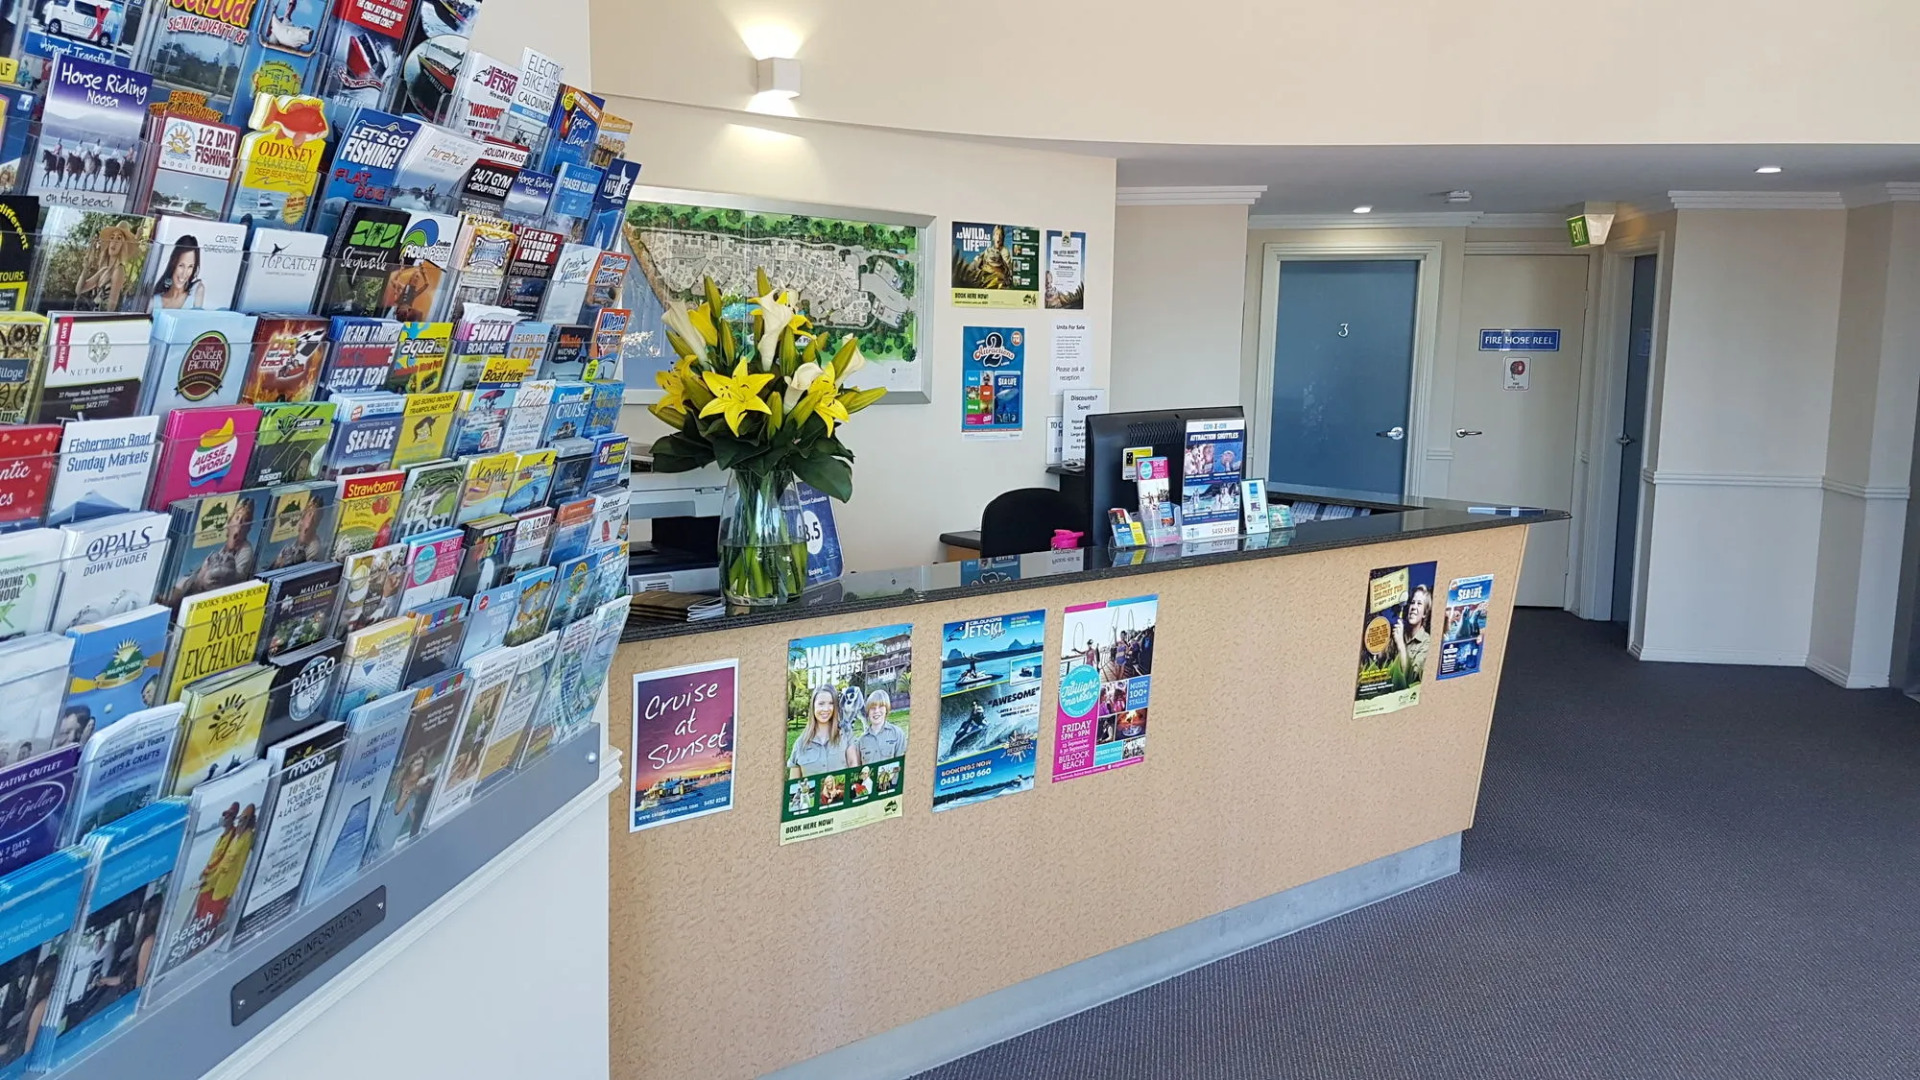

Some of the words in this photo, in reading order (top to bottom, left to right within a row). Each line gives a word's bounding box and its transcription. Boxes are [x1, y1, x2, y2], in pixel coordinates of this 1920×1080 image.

[61, 62, 103, 90] Horse
[105, 74, 149, 105] Riding
[523, 73, 545, 90] BIKE
[86, 90, 119, 108] Noosa
[197, 126, 214, 145] 1/2
[215, 131, 234, 150] DAY
[350, 125, 388, 145] LET'S
[387, 134, 409, 149] GO
[195, 146, 231, 167] FISHING
[258, 140, 316, 162] ODYSSEY
[340, 137, 402, 170] FISHING!
[482, 147, 510, 163] HOLIDAY
[508, 152, 525, 165] PASS
[471, 168, 492, 187] 24/7
[491, 173, 514, 192] GYM
[45, 193, 60, 203] on
[60, 191, 81, 206] the
[81, 194, 114, 209] beach
[524, 229, 537, 240] JET
[962, 227, 985, 240] WILD
[963, 239, 980, 252] LIFE
[519, 249, 549, 263] HIRE
[469, 324, 512, 342] SWAN
[1337, 322, 1350, 338] 3
[401, 339, 437, 359] aqua
[1484, 336, 1503, 345] FIRE
[1504, 336, 1531, 345] HOSE
[1532, 336, 1555, 345] REEL
[187, 359, 224, 372] FACTORY
[191, 350, 224, 362] GINGER
[69, 365, 124, 377] NUTWORKS
[483, 369, 505, 382] Boat
[504, 371, 524, 382] Hire
[1070, 394, 1098, 402] Discounts?
[556, 401, 589, 420] CRUISE
[69, 439, 126, 453] Fishermans
[66, 456, 106, 473] Sunday
[108, 450, 149, 467] Markets
[193, 446, 229, 468] AUSSIE
[199, 454, 232, 474] WORLD
[347, 479, 399, 498] Strawberry
[86, 526, 153, 562] OPALS
[83, 560, 113, 577] DOWN
[115, 551, 148, 568] UNDER
[208, 602, 249, 644] BOOK
[961, 621, 1003, 640] JETSKI
[182, 631, 257, 681] EXCHANGE
[793, 658, 807, 670] AS
[805, 643, 852, 668] WILD
[289, 656, 337, 698] PALEO
[807, 665, 841, 690] LIFE
[644, 682, 719, 721] Cruise
[1129, 689, 1148, 699] 100+
[674, 708, 698, 736] at
[1061, 719, 1092, 735] FRIDAY
[647, 722, 729, 771] Sunset
[1058, 750, 1090, 764] BULCOCK
[1061, 758, 1086, 771] BEACH
[28, 759, 64, 779] OUTLET
[940, 776, 961, 786] 0434
[960, 771, 976, 781] 330
[975, 767, 992, 778] 660
[941, 763, 977, 778] BOOKINGS
[975, 759, 993, 768] NOW
[785, 823, 802, 834] BOOK
[802, 820, 818, 831] HERE
[817, 817, 835, 829] NOW!
[169, 912, 213, 947] Beach
[168, 926, 216, 961] Safety
[264, 952, 303, 983] VISITOR
